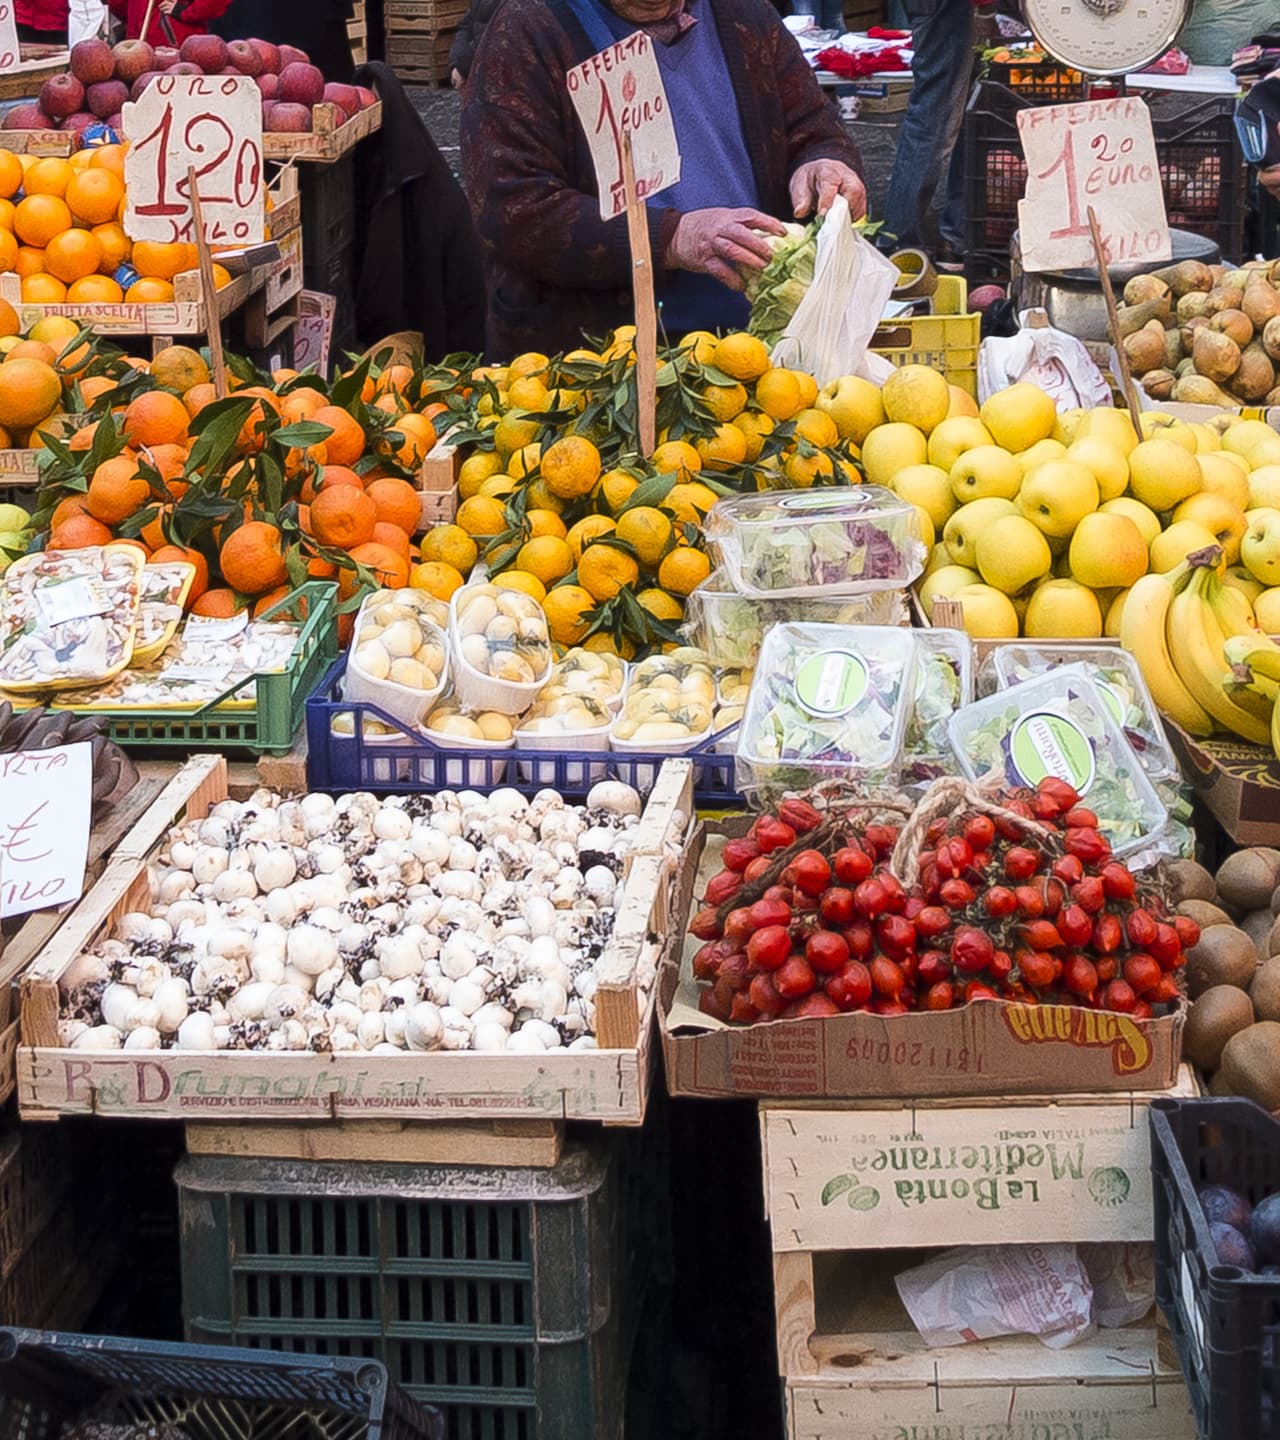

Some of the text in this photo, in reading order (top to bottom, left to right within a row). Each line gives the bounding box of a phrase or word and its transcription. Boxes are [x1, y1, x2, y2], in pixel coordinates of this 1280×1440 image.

[568, 33, 648, 92] OFFERTA
[134, 101, 261, 216] 120
[1085, 163, 1153, 195] EURO
[169, 217, 250, 244] KILO
[95, 304, 144, 321] SCELTA
[893, 1176, 1040, 1211] La Bontà
